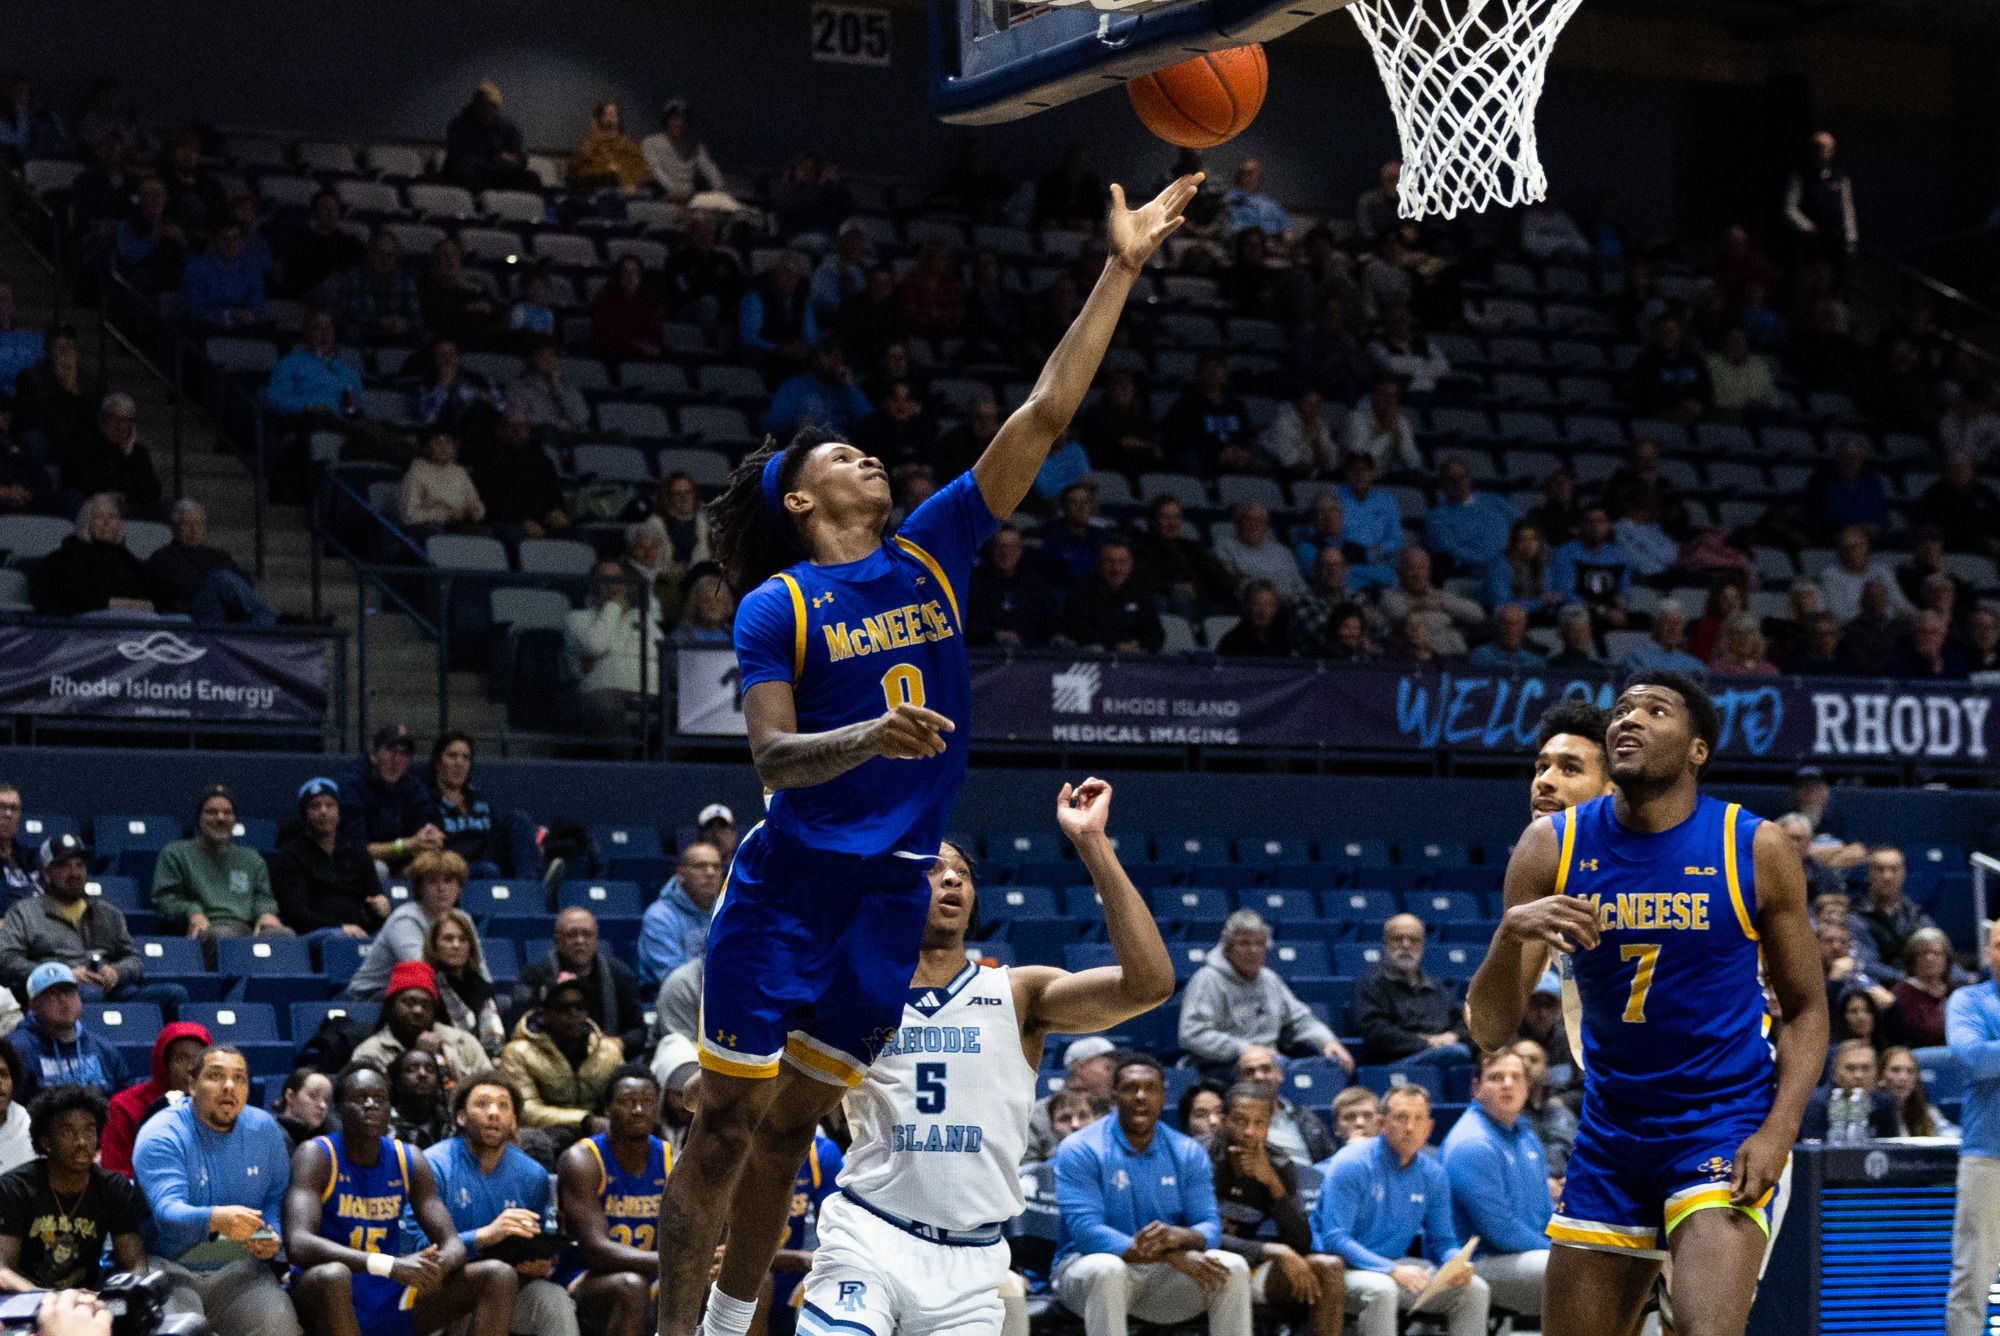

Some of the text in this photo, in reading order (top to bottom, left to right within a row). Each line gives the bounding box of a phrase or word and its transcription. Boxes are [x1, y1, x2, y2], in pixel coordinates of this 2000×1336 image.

[816, 11, 887, 58] 205
[822, 599, 954, 663] McNEESE
[50, 675, 274, 709] Rhode Island Energy
[1102, 697, 1241, 718] RHODE ISLAND
[1397, 672, 1784, 756] WELC TO
[1052, 724, 1241, 746] MEDICAL IMAGING
[1811, 693, 1992, 757] RHODY
[966, 996, 1002, 1006] A10
[1620, 943, 1663, 1024] 7
[916, 1062, 946, 1114] 5
[892, 1124, 983, 1153] SLAND
